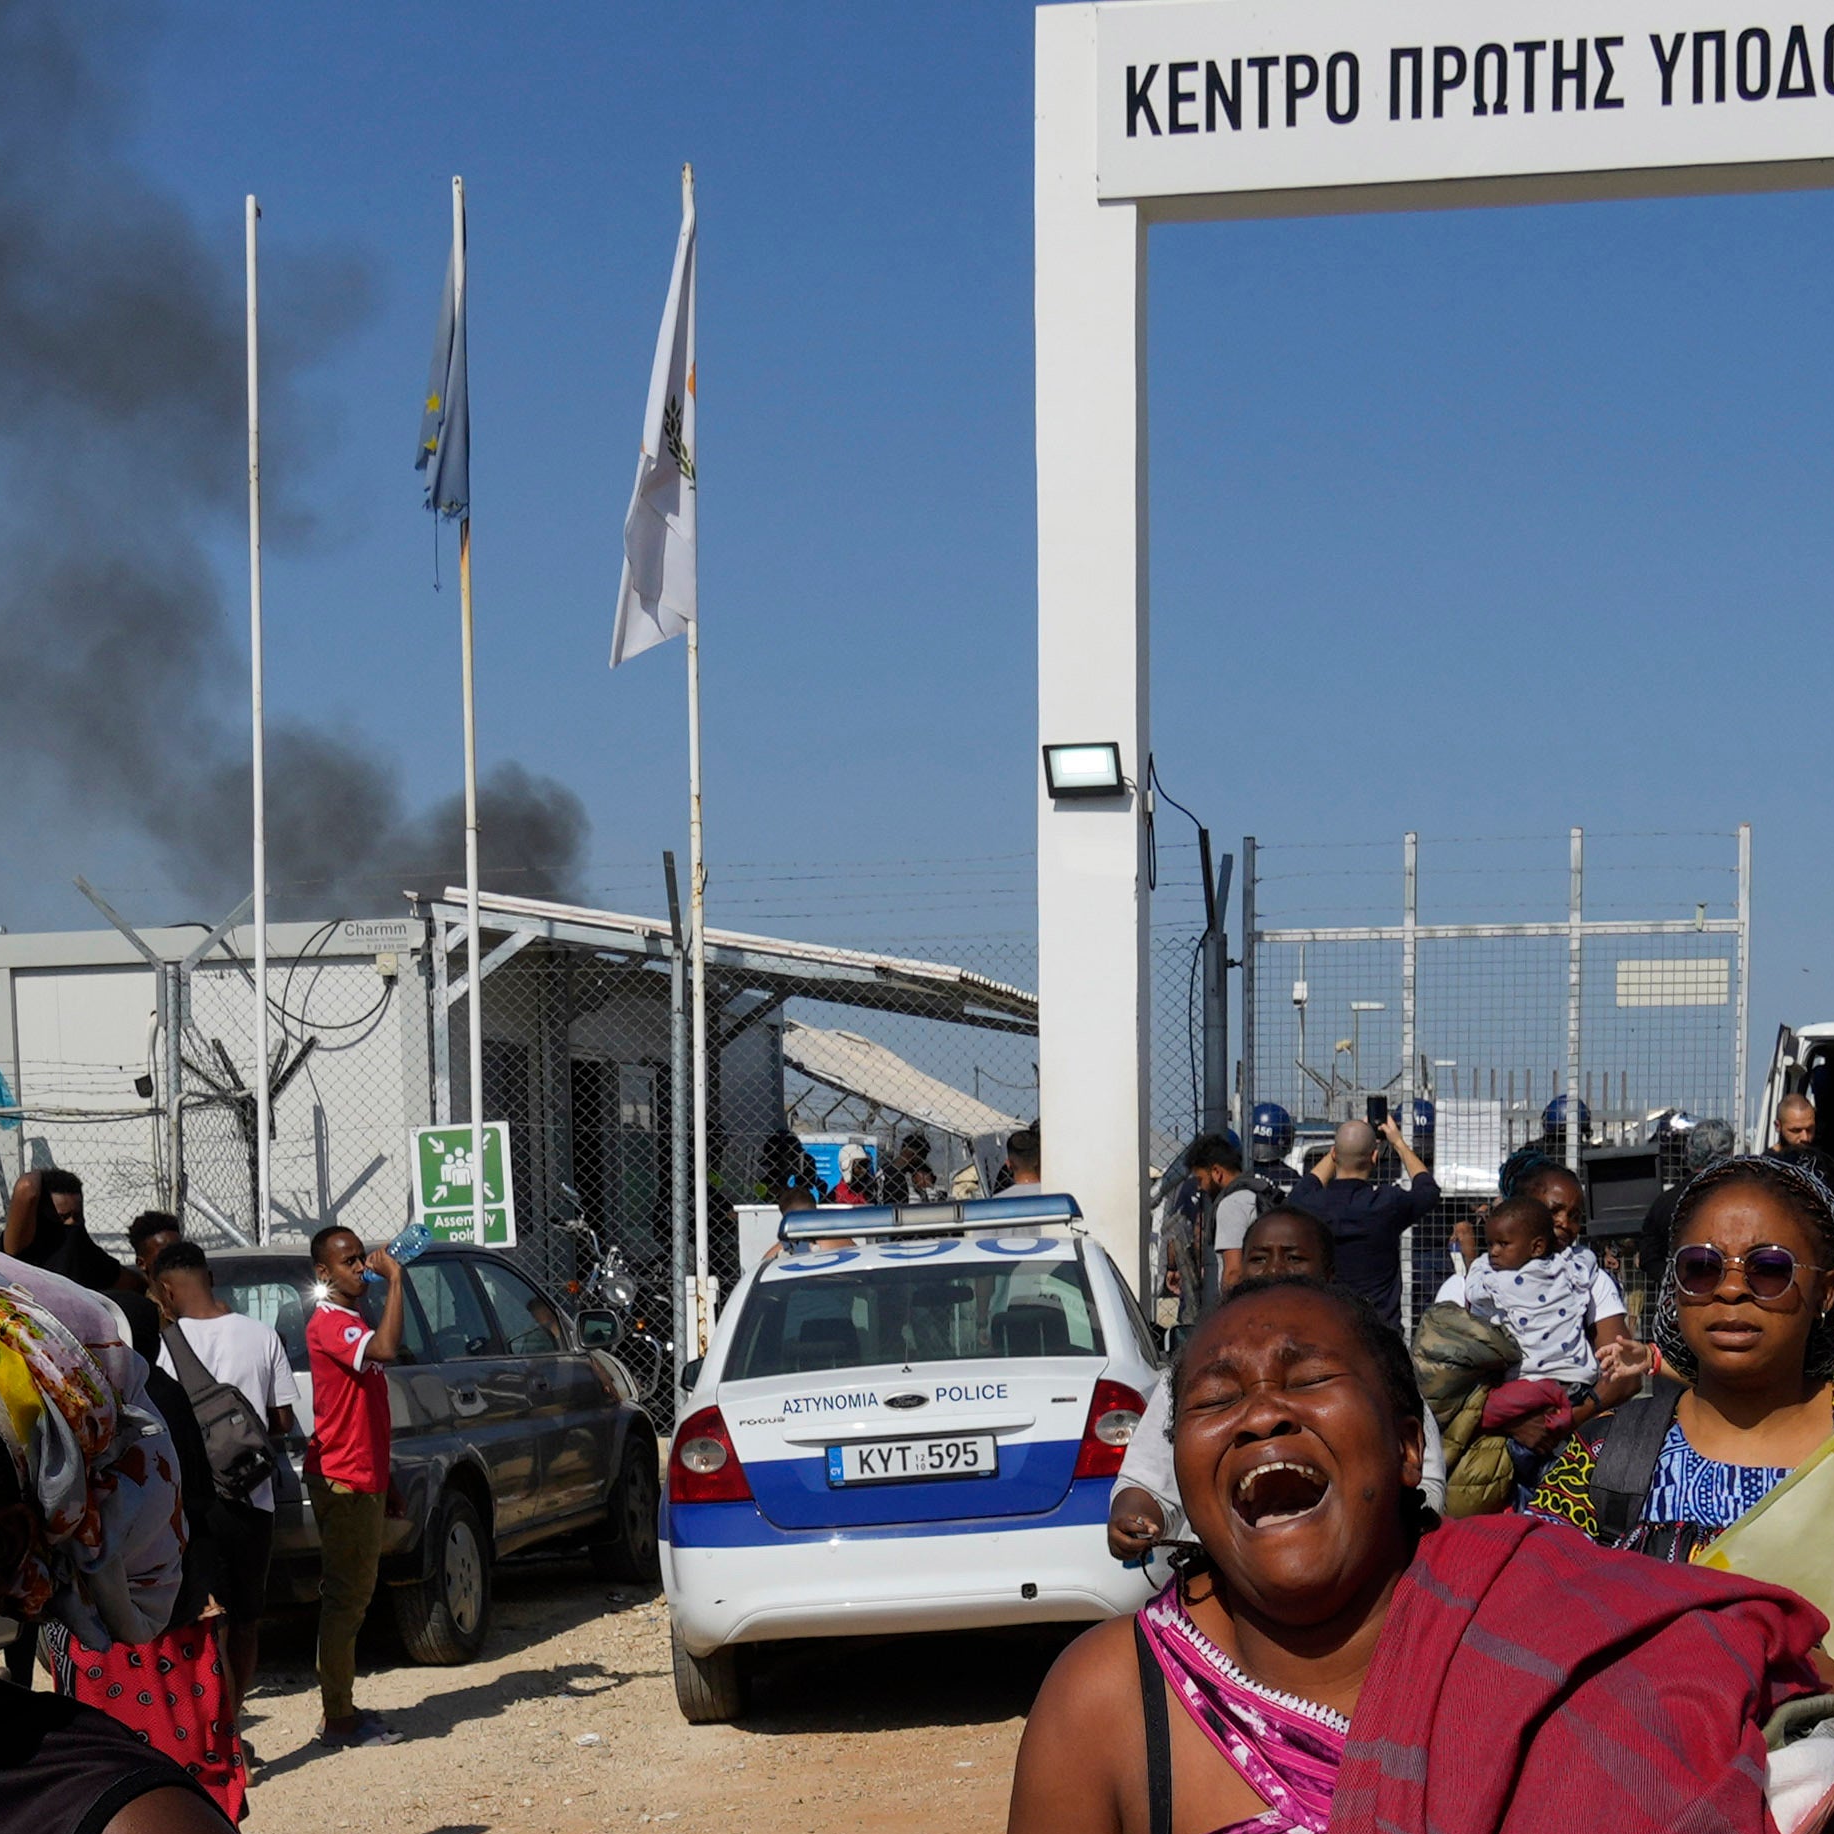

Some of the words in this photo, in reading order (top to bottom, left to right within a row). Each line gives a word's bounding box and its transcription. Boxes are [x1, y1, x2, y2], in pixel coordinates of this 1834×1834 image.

[1125, 51, 1361, 138] ΚΕΝΤΡΟ
[1388, 36, 1625, 121] ΠΡΩΤΗΣ
[344, 923, 408, 937] Charmm
[434, 1211, 496, 1228] Assemly
[782, 1392, 879, 1414] ΑΣΤΥΝΟΜΙΑ
[935, 1384, 1009, 1402] POLICE
[858, 1446, 912, 1475] KYT
[927, 1441, 979, 1470] 595
